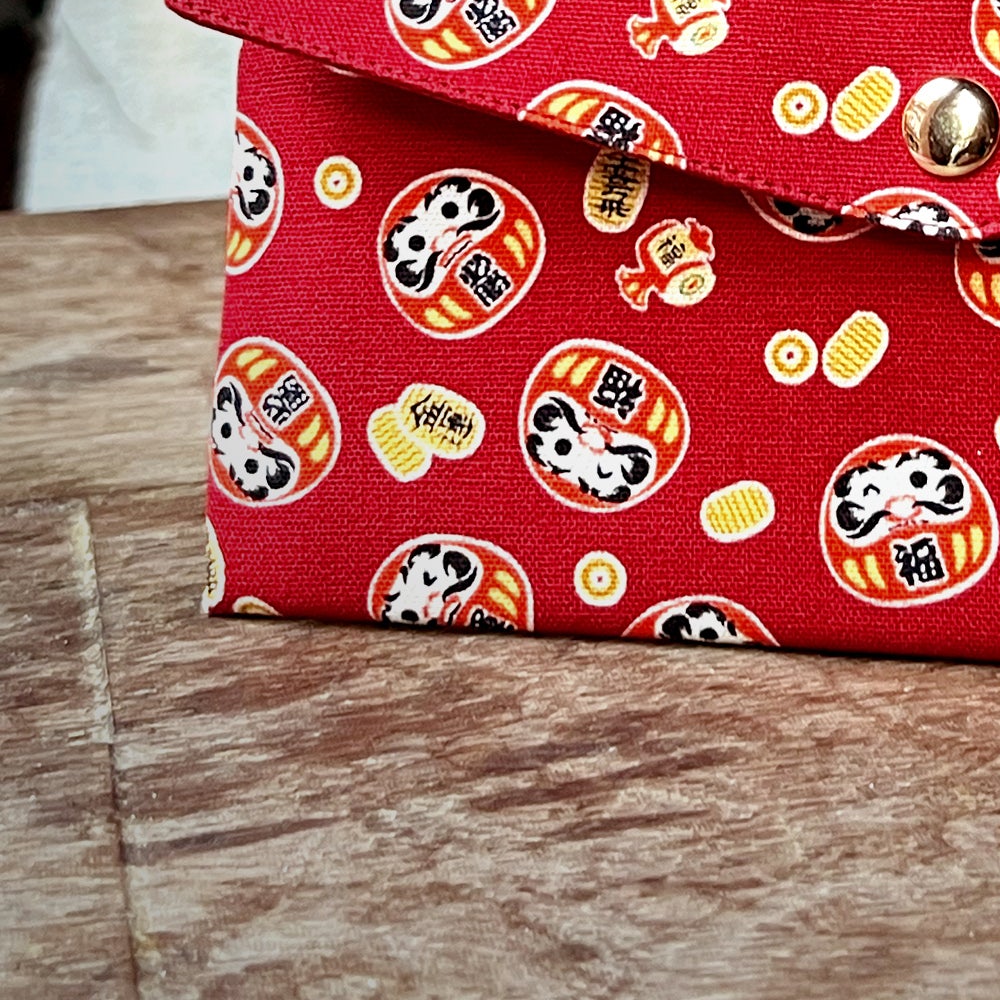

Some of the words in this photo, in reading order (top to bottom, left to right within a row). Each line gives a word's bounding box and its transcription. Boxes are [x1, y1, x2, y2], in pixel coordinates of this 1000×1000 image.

[592, 363, 643, 420] 福
[410, 393, 474, 446] 金運
[893, 537, 945, 586] 福
